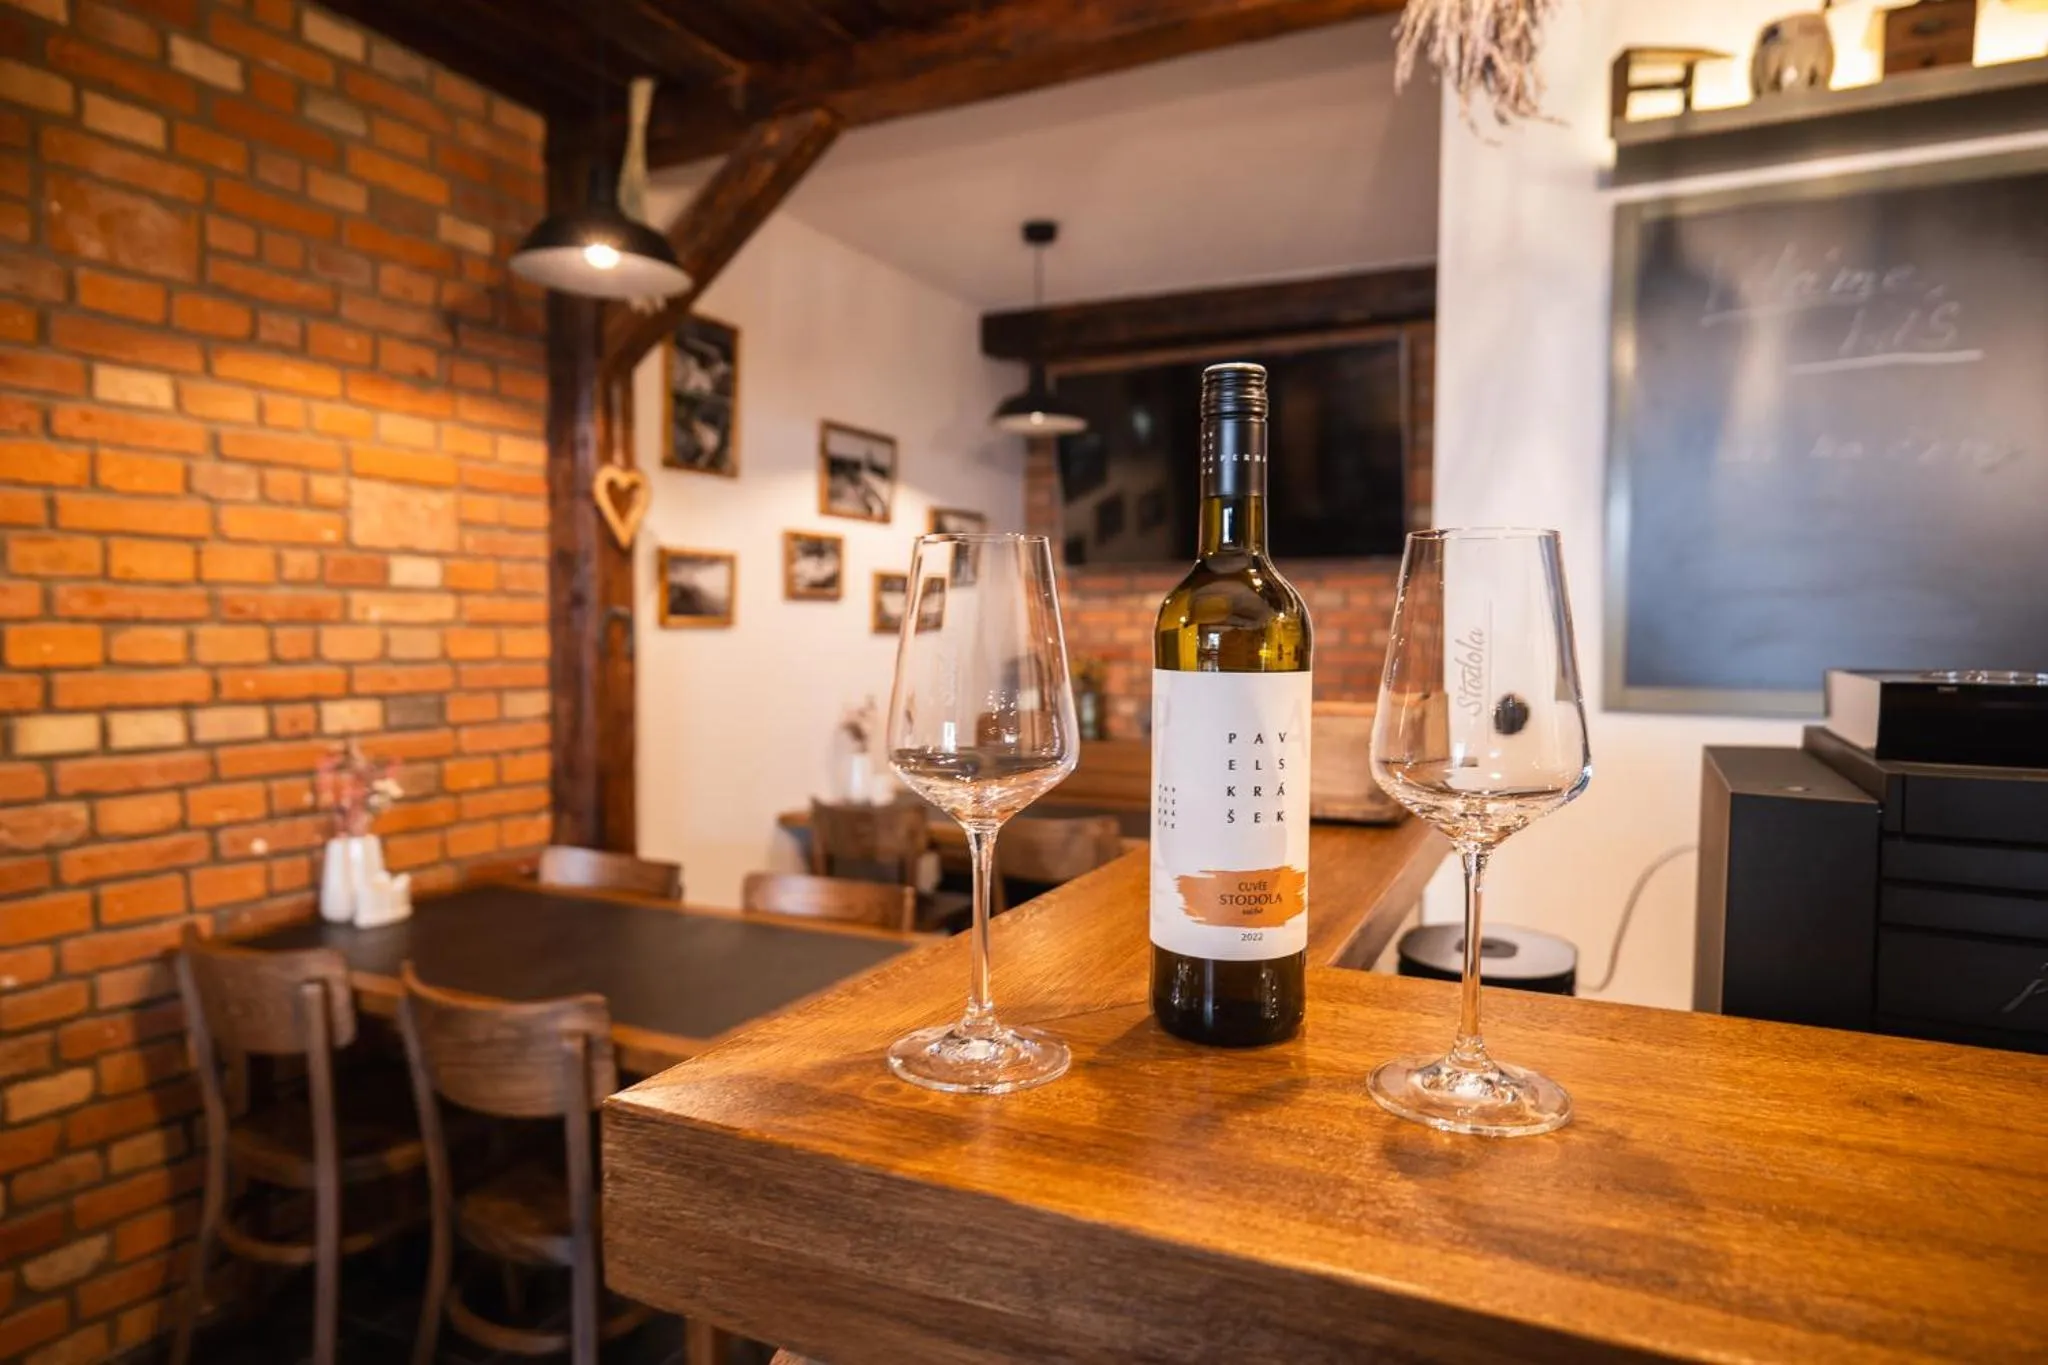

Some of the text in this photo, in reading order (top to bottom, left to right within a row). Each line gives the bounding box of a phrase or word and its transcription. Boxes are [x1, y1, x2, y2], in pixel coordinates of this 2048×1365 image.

[1454, 626, 1485, 717] Stodola
[1237, 880, 1269, 892] CUVÉE
[1219, 893, 1283, 906] STODOLA
[1241, 932, 1264, 942] 2022
